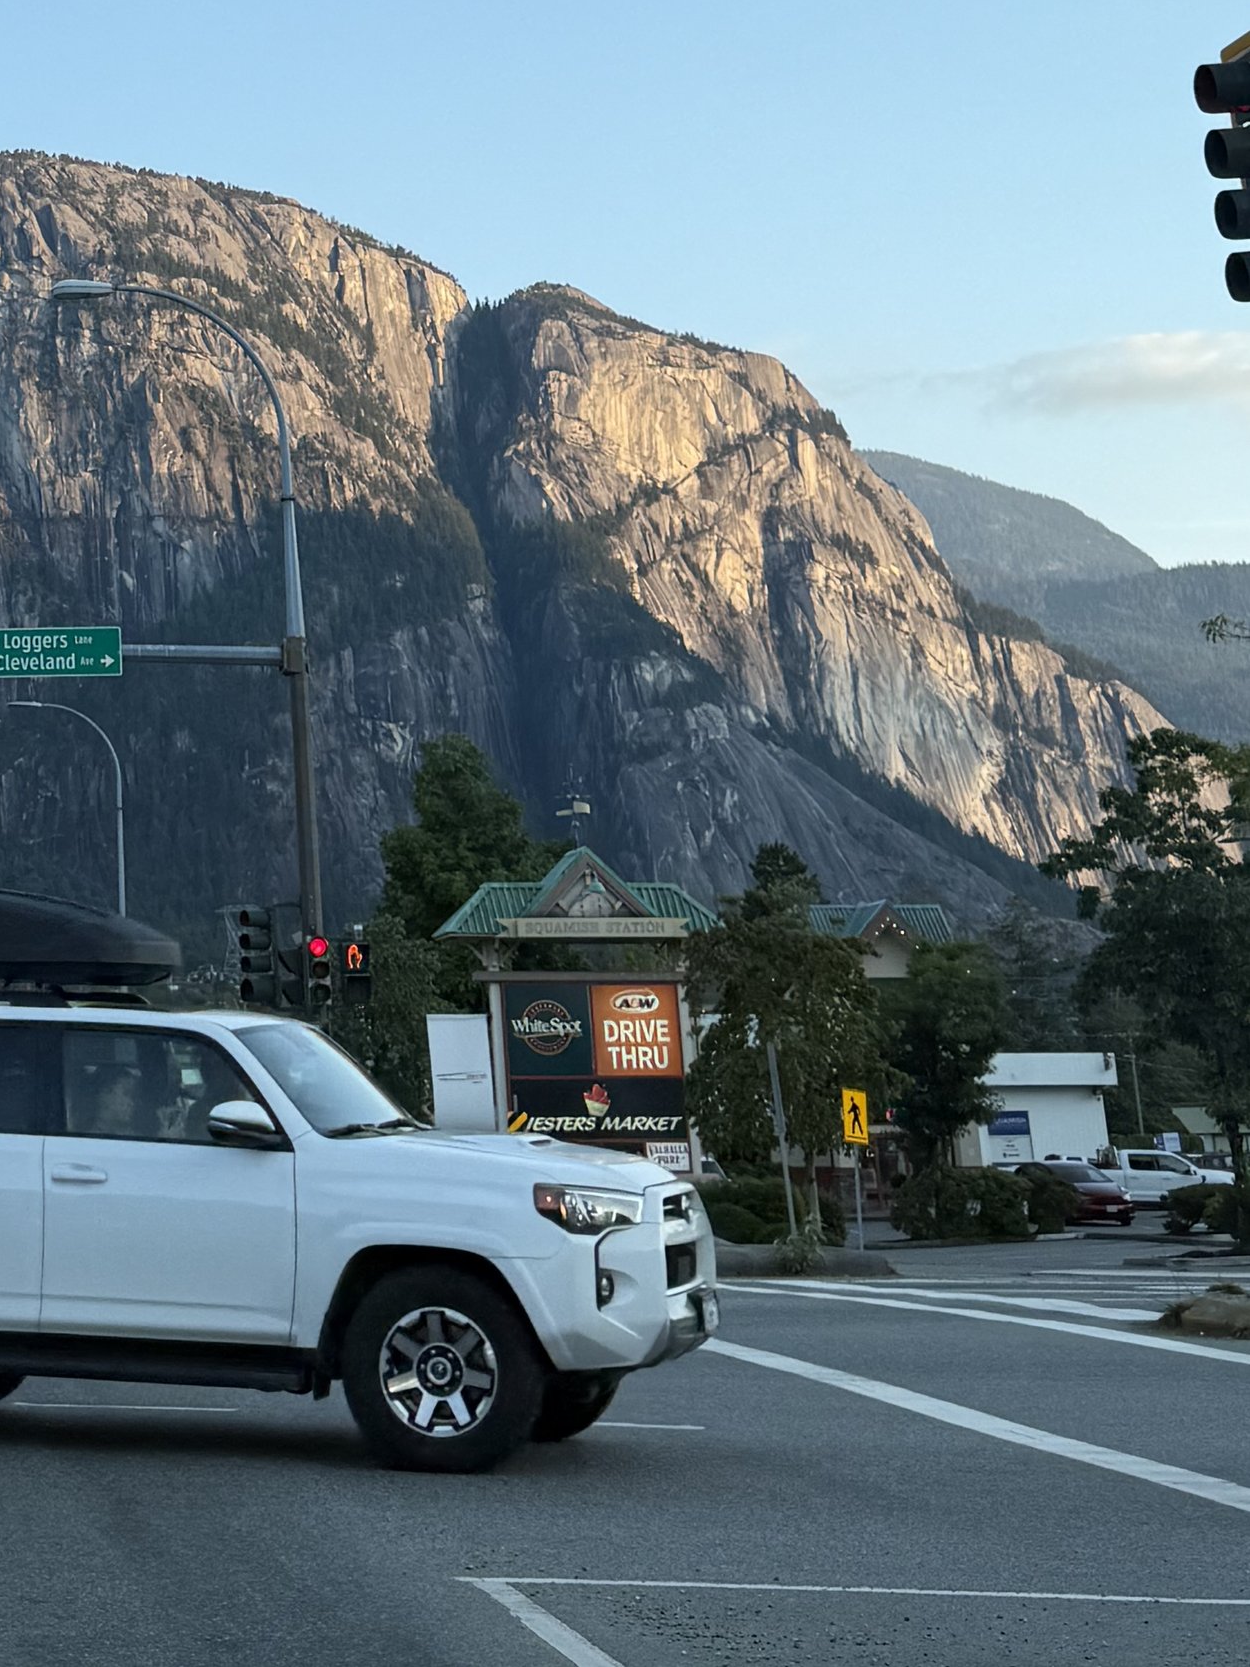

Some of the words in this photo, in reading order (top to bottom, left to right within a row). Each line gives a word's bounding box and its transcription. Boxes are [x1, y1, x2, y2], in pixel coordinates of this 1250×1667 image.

[3, 633, 68, 653] Loggers
[74, 635, 93, 645] Lane
[80, 656, 94, 666] Ave
[525, 921, 599, 935] SQUAMISH
[607, 921, 665, 934] STATION
[603, 1019, 671, 1043] DRIVE
[608, 1045, 669, 1070] THRU
[601, 1115, 682, 1131] MARKET
